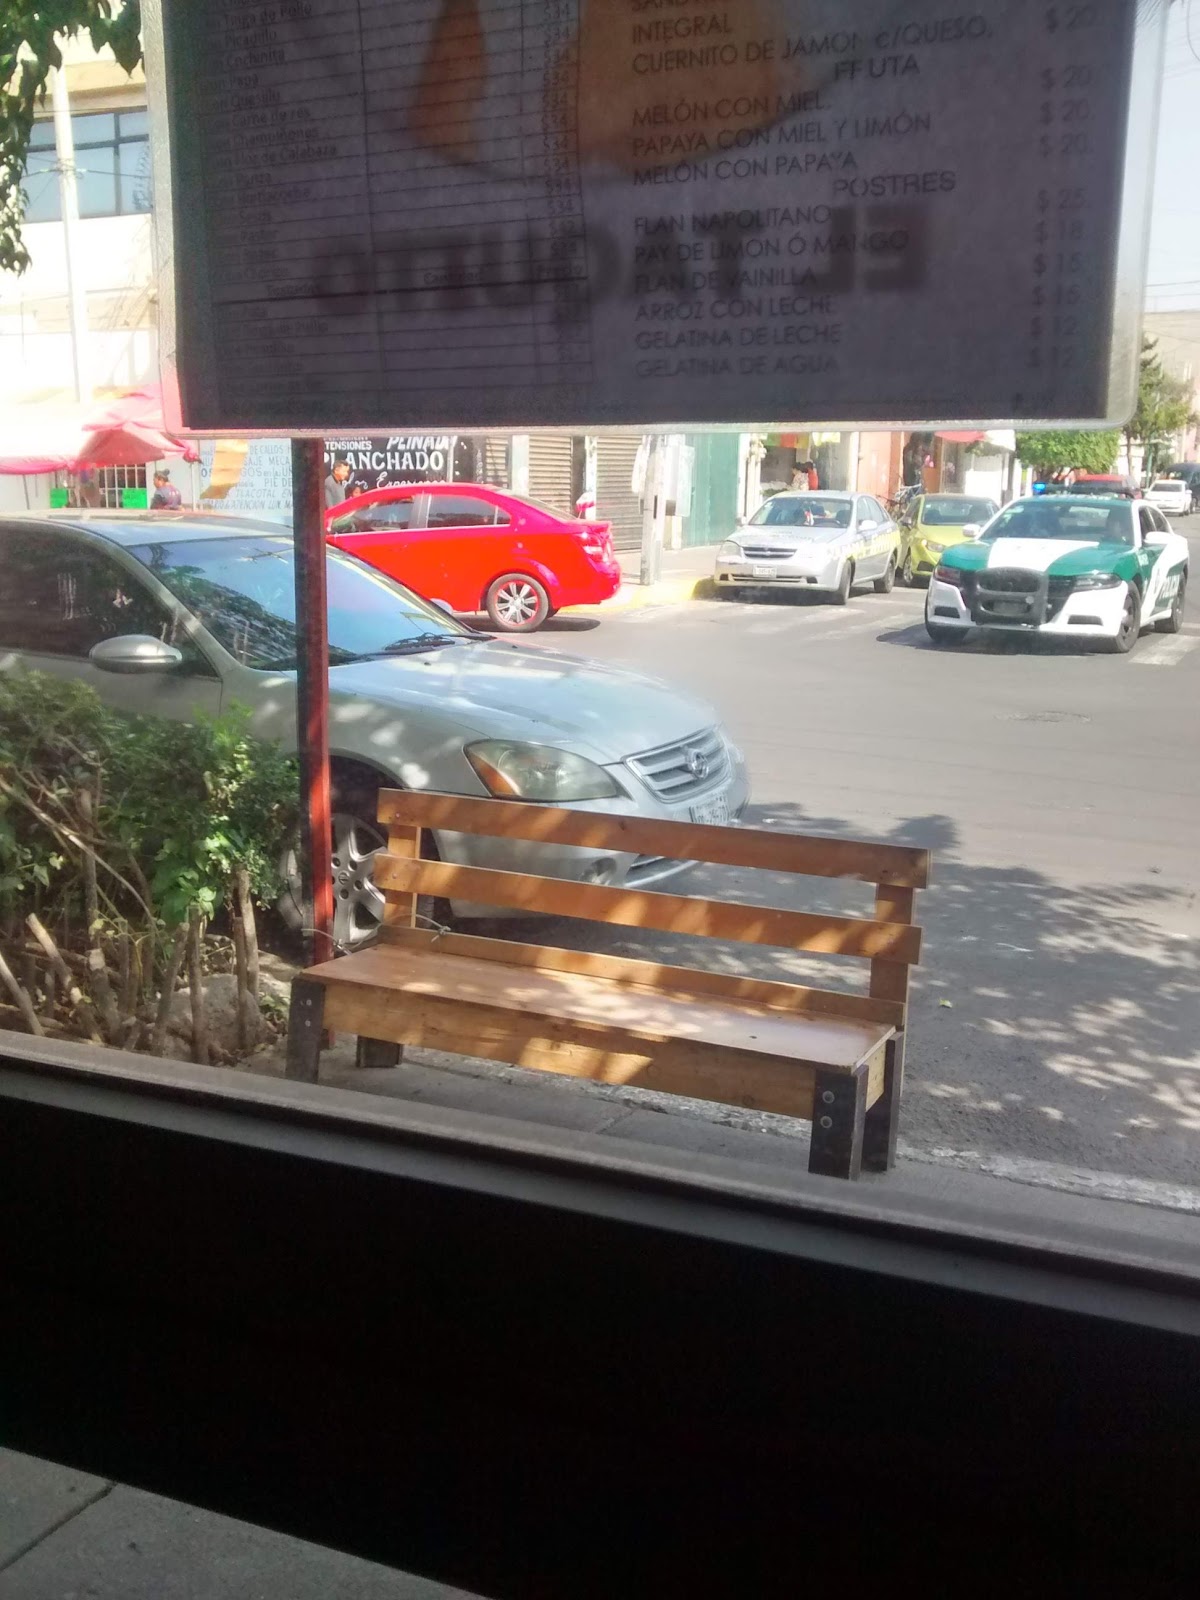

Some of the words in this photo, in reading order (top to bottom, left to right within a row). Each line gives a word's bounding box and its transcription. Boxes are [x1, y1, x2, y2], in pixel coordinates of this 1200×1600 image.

[632, 13, 733, 44] INTEGRAL
[632, 44, 738, 75] CUERNITO
[745, 39, 775, 63] DE
[632, 98, 709, 127] MELÓN
[715, 95, 769, 120] CON
[632, 132, 709, 156] PAPAYA
[717, 127, 770, 151] CON
[777, 122, 827, 146] MIEL
[834, 117, 847, 140] Y
[632, 160, 709, 186] MELÓN
[714, 157, 769, 181] CON
[775, 151, 858, 176] PAPAYA
[832, 169, 956, 198] POSTRES
[634, 215, 685, 235] FLAN
[692, 204, 832, 233] NAPOLITANO
[635, 243, 669, 265] PAY
[676, 242, 704, 262] DE
[710, 237, 781, 261] LIMON
[787, 231, 807, 256] Ó
[634, 272, 686, 295] FLAN
[692, 270, 720, 291] DE
[726, 265, 818, 289] VAINILLA
[635, 299, 703, 322] ARROZ
[710, 297, 763, 320] CON
[769, 295, 838, 318] LECHE
[635, 328, 733, 350] GELATINA
[740, 326, 768, 346] DE
[773, 323, 843, 346] LECHE
[635, 357, 730, 379] GELATINA
[739, 355, 767, 375] DE
[773, 353, 841, 375] AGUA
